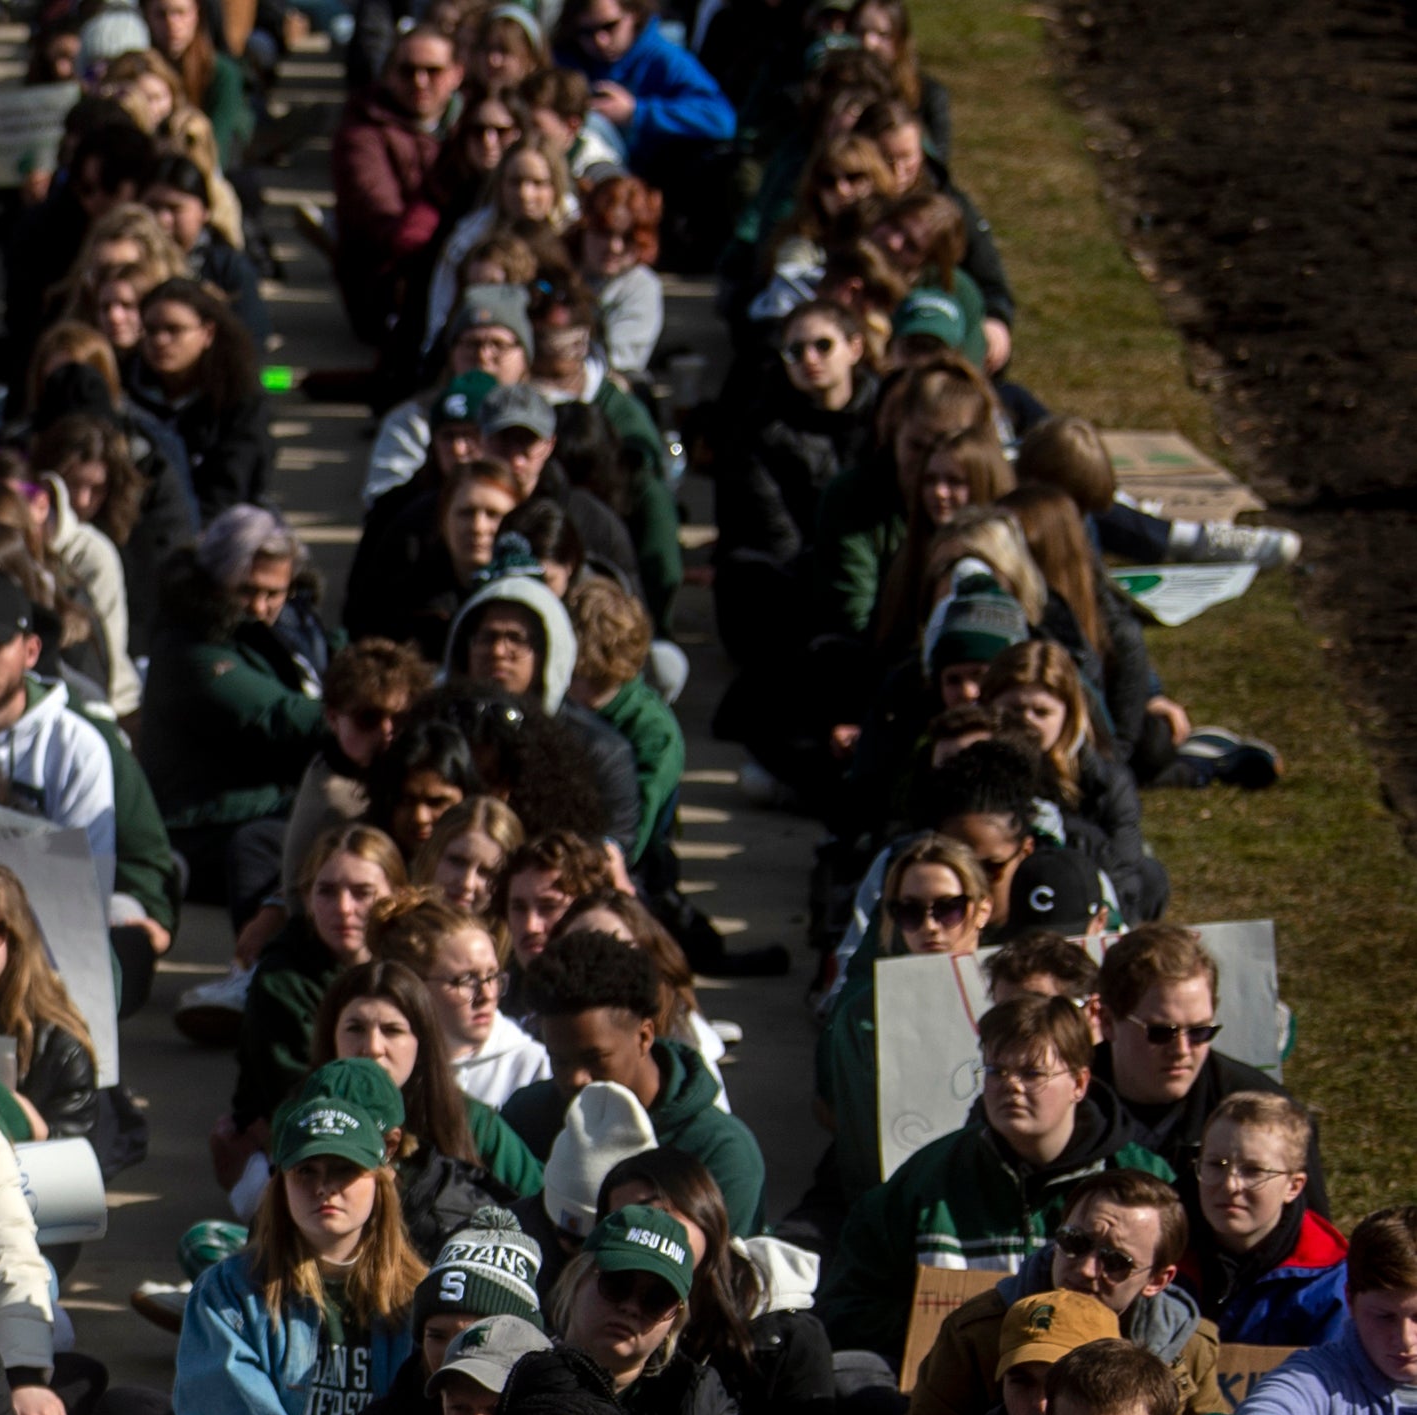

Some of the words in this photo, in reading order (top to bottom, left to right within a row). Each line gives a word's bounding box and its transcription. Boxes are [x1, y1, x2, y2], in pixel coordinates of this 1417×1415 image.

[627, 1227, 661, 1252] MSU
[658, 1235, 687, 1266] LAW
[439, 1271, 466, 1301] S
